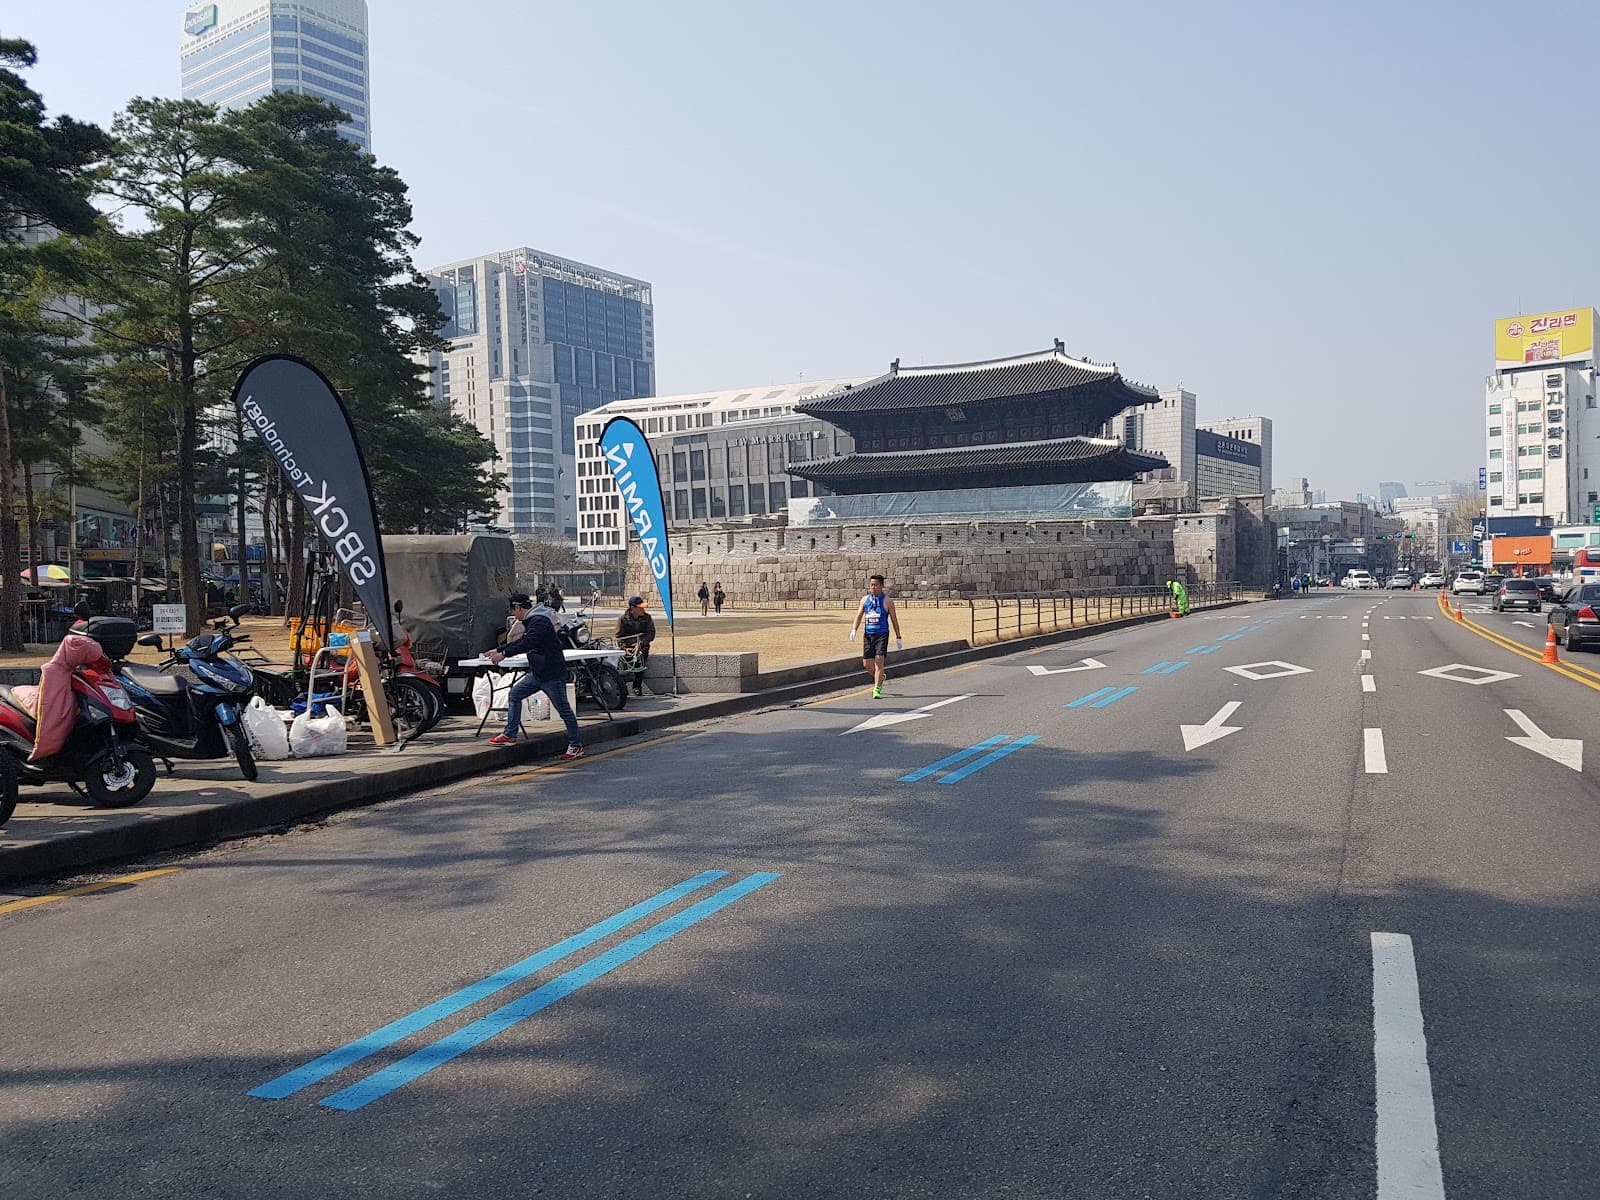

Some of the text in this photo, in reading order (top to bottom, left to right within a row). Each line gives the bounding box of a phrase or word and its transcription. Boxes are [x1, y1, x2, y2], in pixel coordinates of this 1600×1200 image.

[1529, 313, 1577, 334] 진라면
[1545, 373, 1565, 460] 금자탑학원
[751, 430, 811, 446] MARRIOTT
